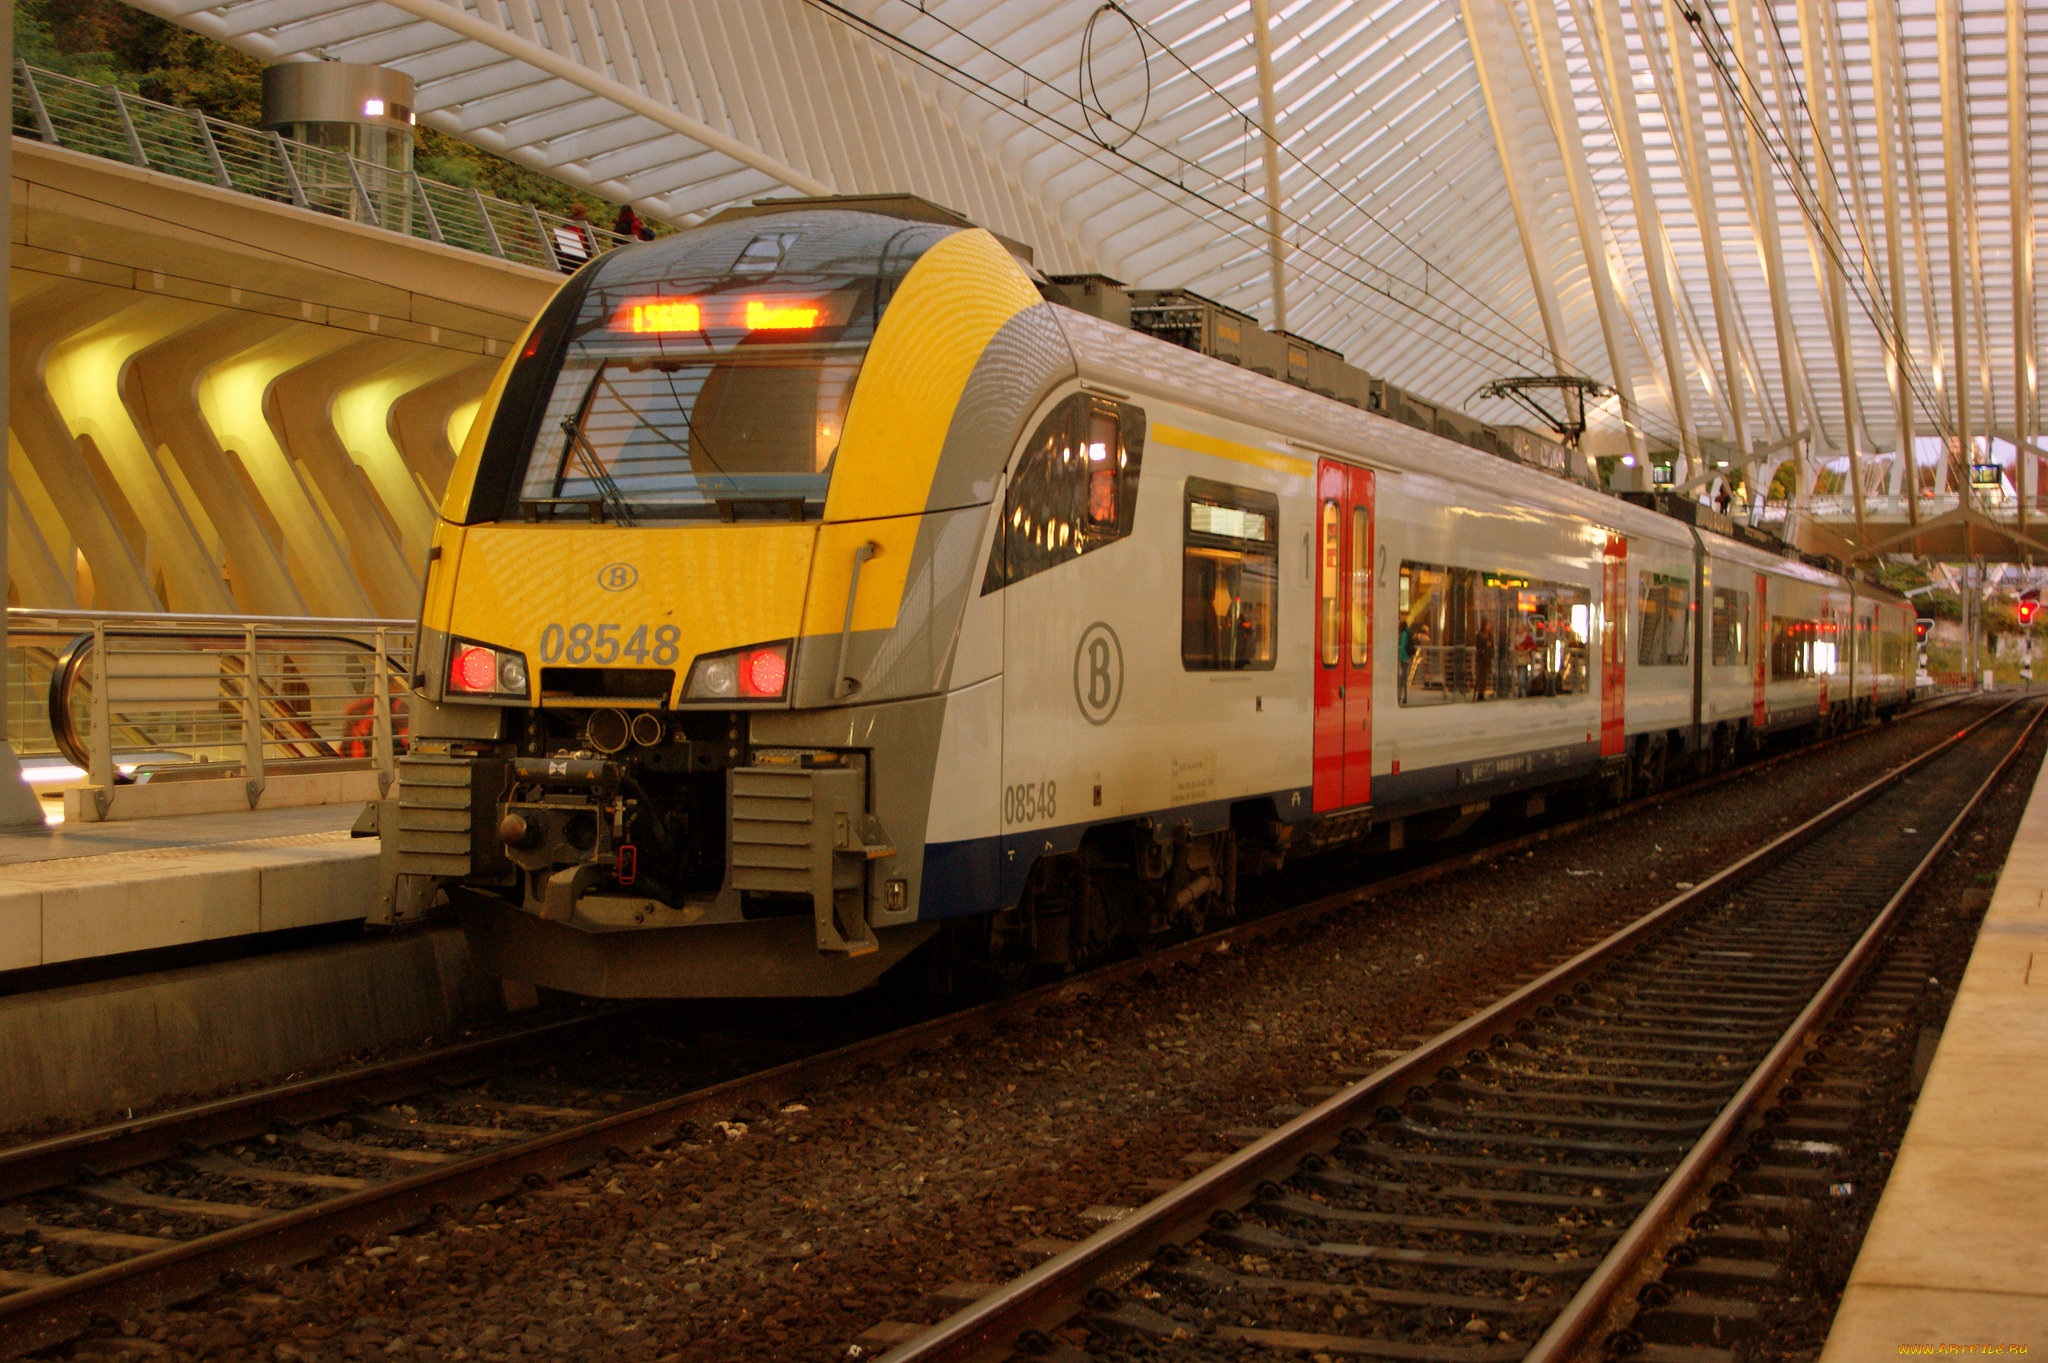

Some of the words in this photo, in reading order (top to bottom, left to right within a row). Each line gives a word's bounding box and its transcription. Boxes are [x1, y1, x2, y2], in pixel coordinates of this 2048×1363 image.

[1379, 544, 1386, 587] 2
[540, 623, 681, 665] 08548
[1005, 780, 1056, 825] 08548
